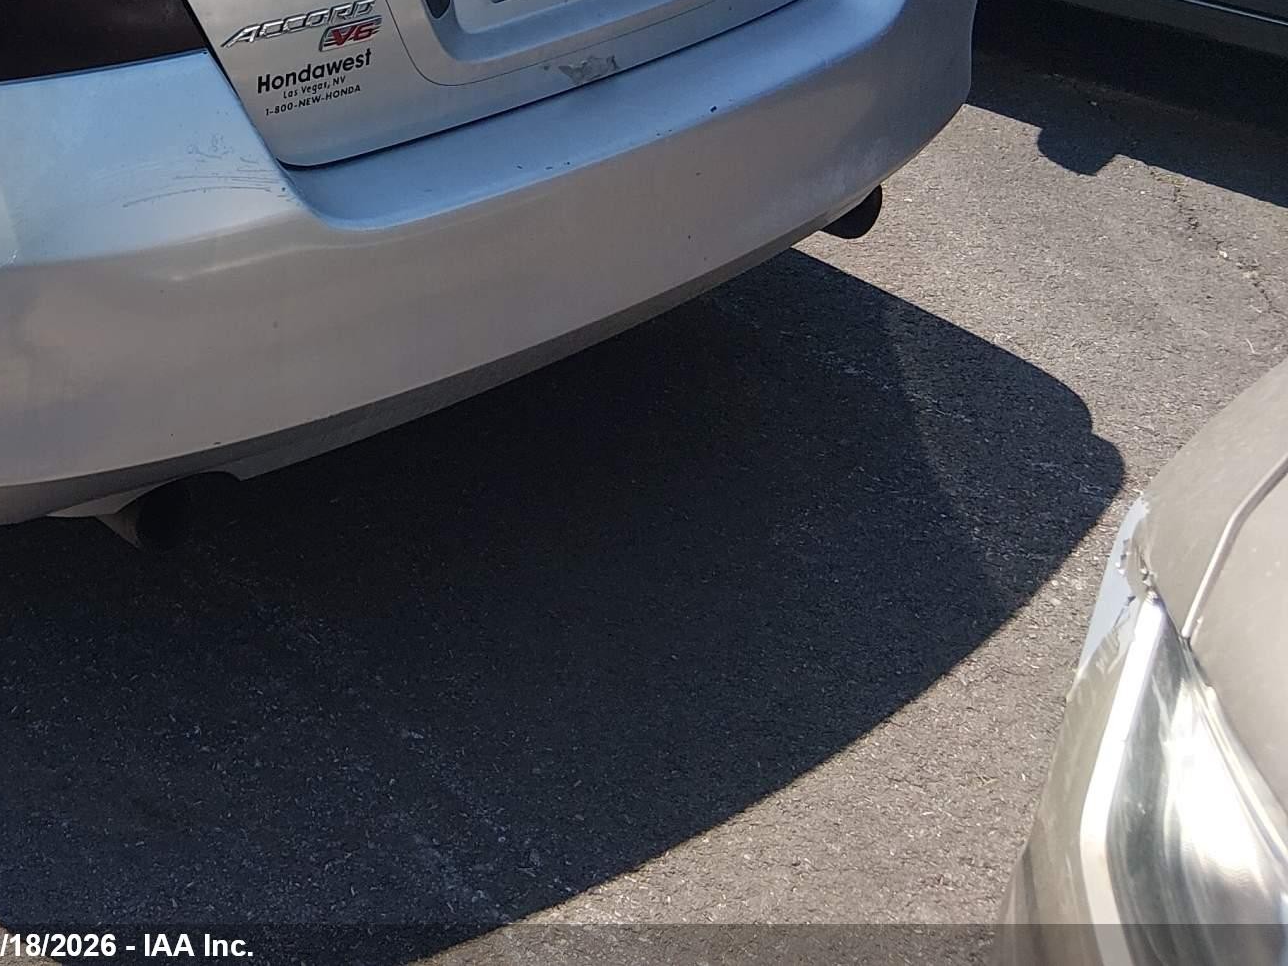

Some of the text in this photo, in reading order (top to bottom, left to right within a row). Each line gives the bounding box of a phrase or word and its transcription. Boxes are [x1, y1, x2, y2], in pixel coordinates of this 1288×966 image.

[330, 21, 379, 47] V6
[257, 47, 372, 94] Hondawest
[265, 84, 361, 116] 1-800-NEW-HONDA
[283, 89, 298, 99] Las
[332, 75, 346, 86] NV
